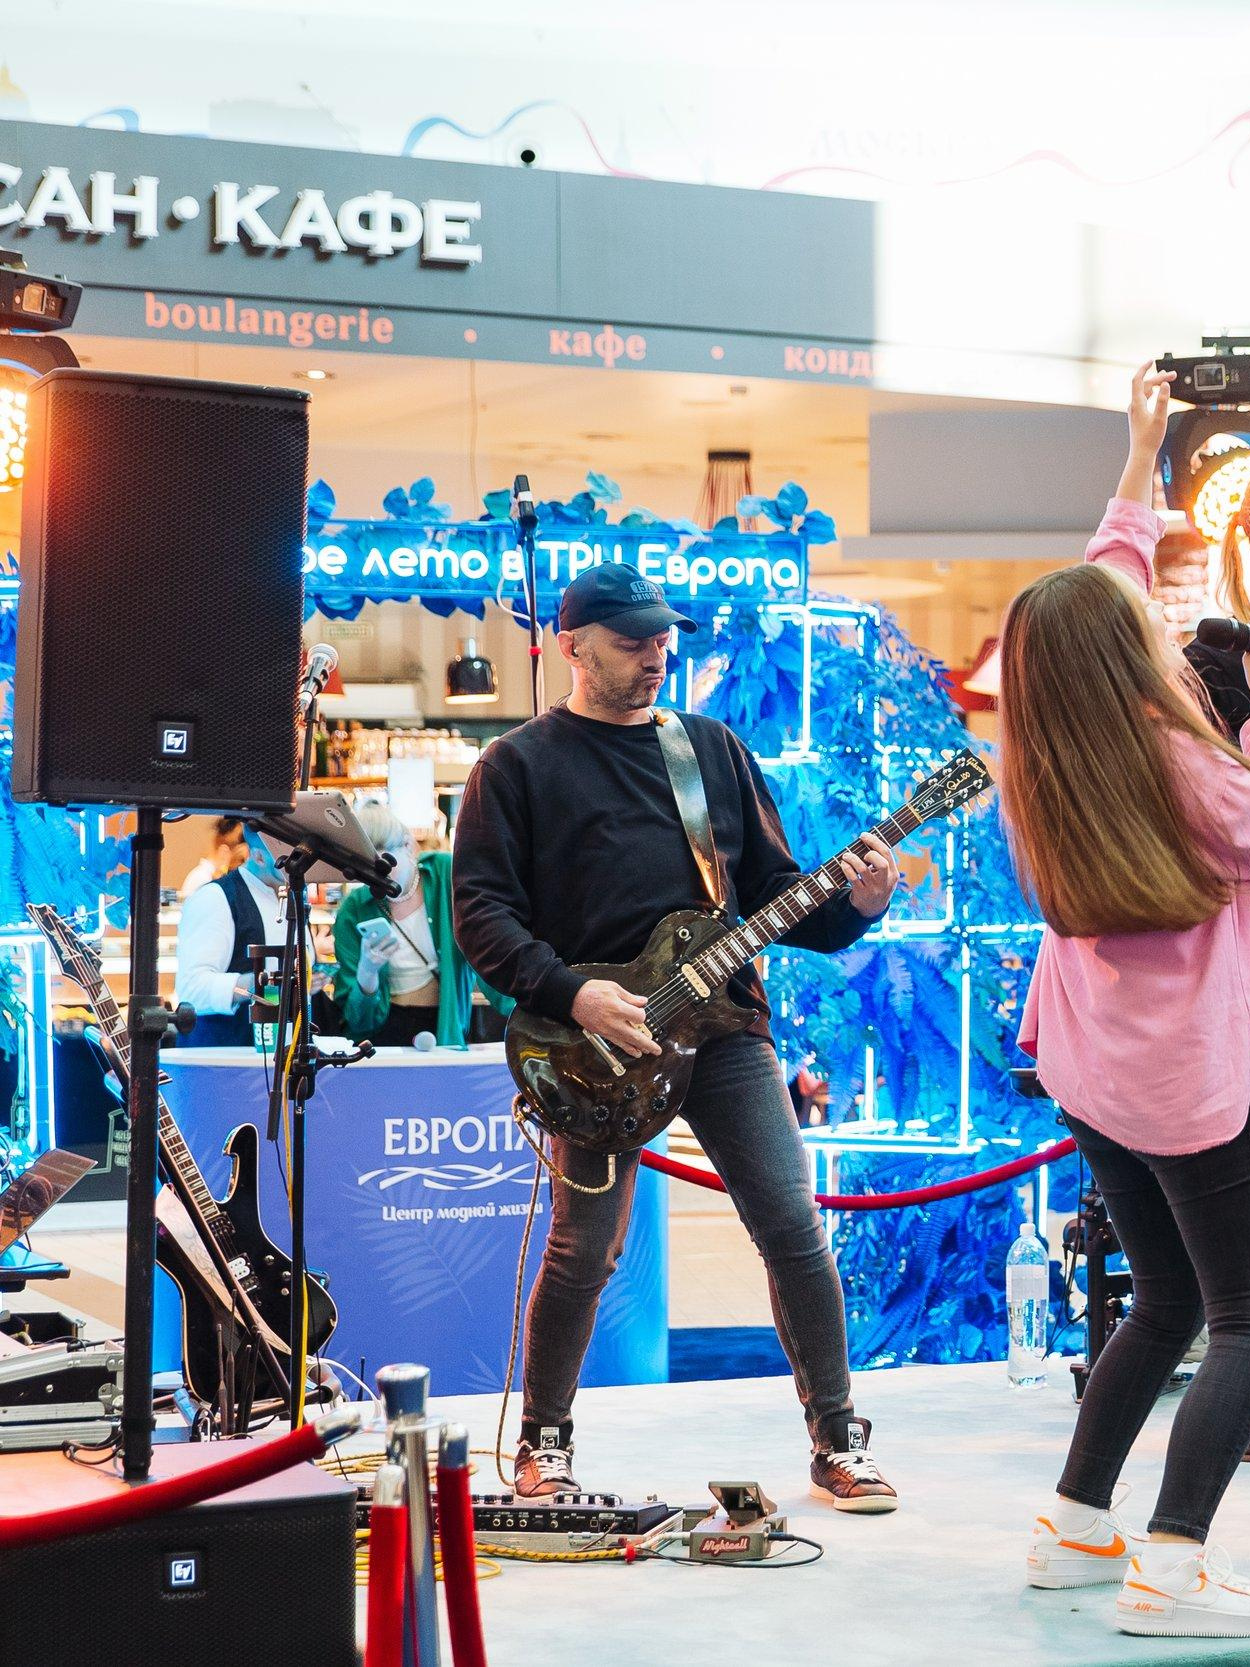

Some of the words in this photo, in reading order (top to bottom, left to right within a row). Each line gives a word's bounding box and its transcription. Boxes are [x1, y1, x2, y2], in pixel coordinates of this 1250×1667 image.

[213, 181, 482, 266] КАФЕ
[144, 291, 394, 347] boulangerie
[548, 324, 647, 368] кафе
[637, 543, 800, 596] Европа
[382, 1205, 434, 1224] Центр
[436, 1202, 496, 1223] модной
[1133, 1601, 1153, 1613] AIR
